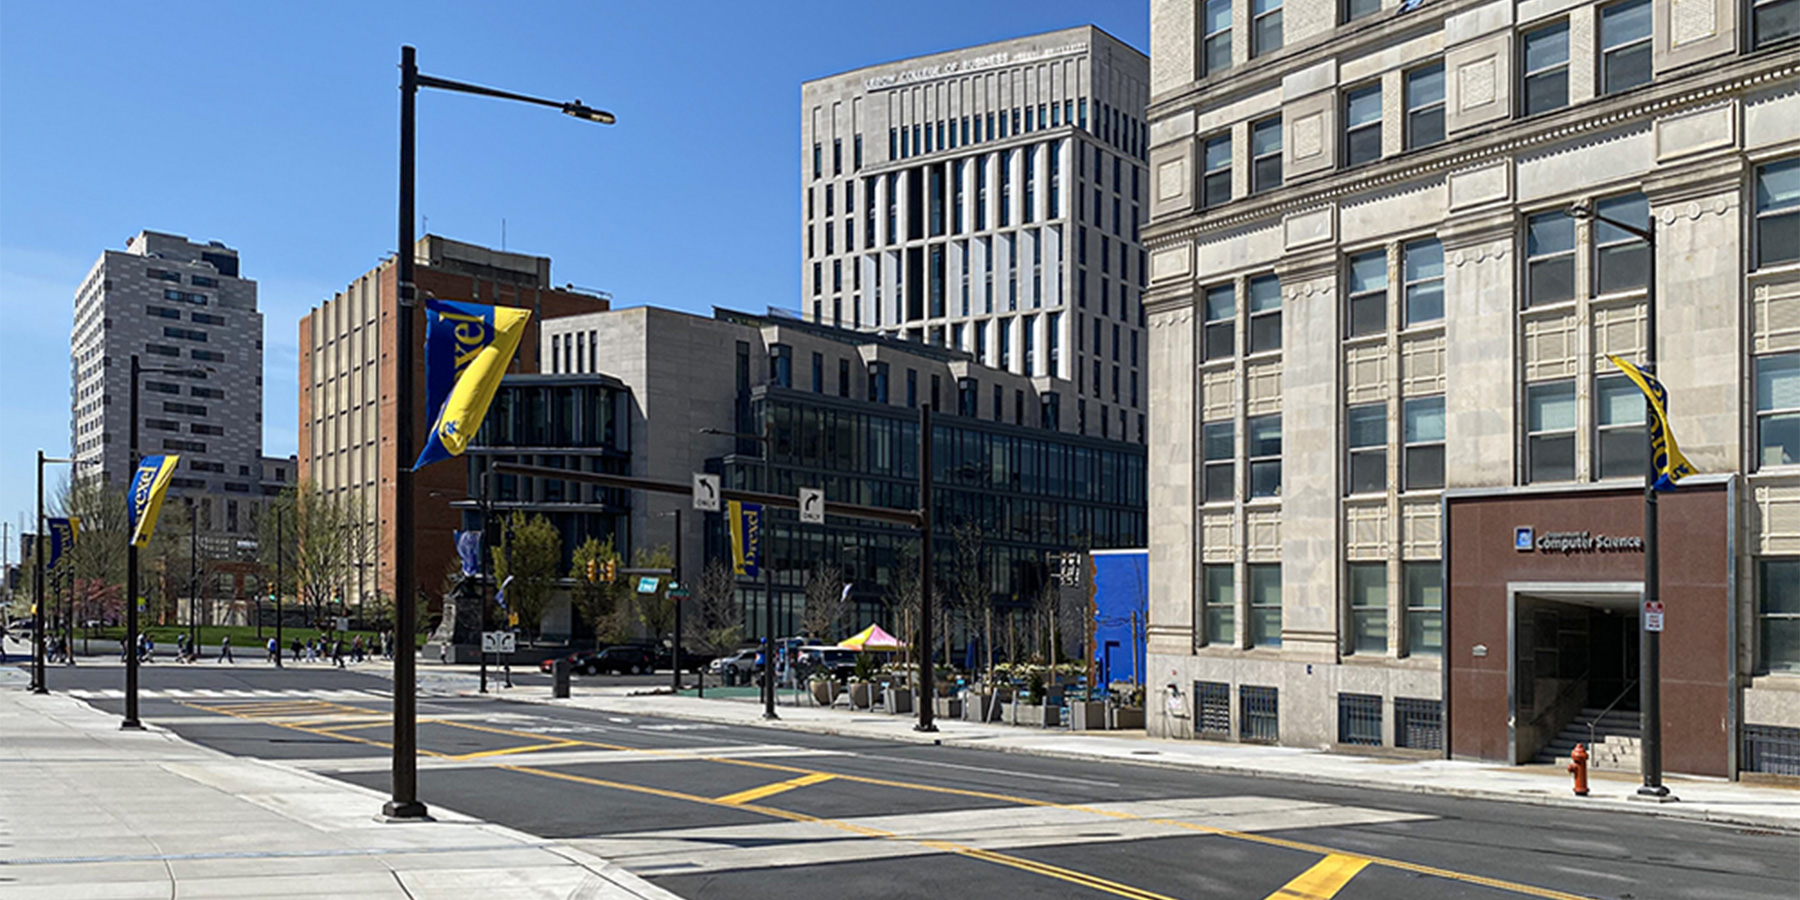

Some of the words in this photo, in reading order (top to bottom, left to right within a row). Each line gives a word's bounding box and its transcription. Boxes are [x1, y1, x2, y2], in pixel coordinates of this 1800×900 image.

[945, 62, 960, 73] OF
[1536, 536, 1593, 551] Computer
[1596, 534, 1641, 548] Science
